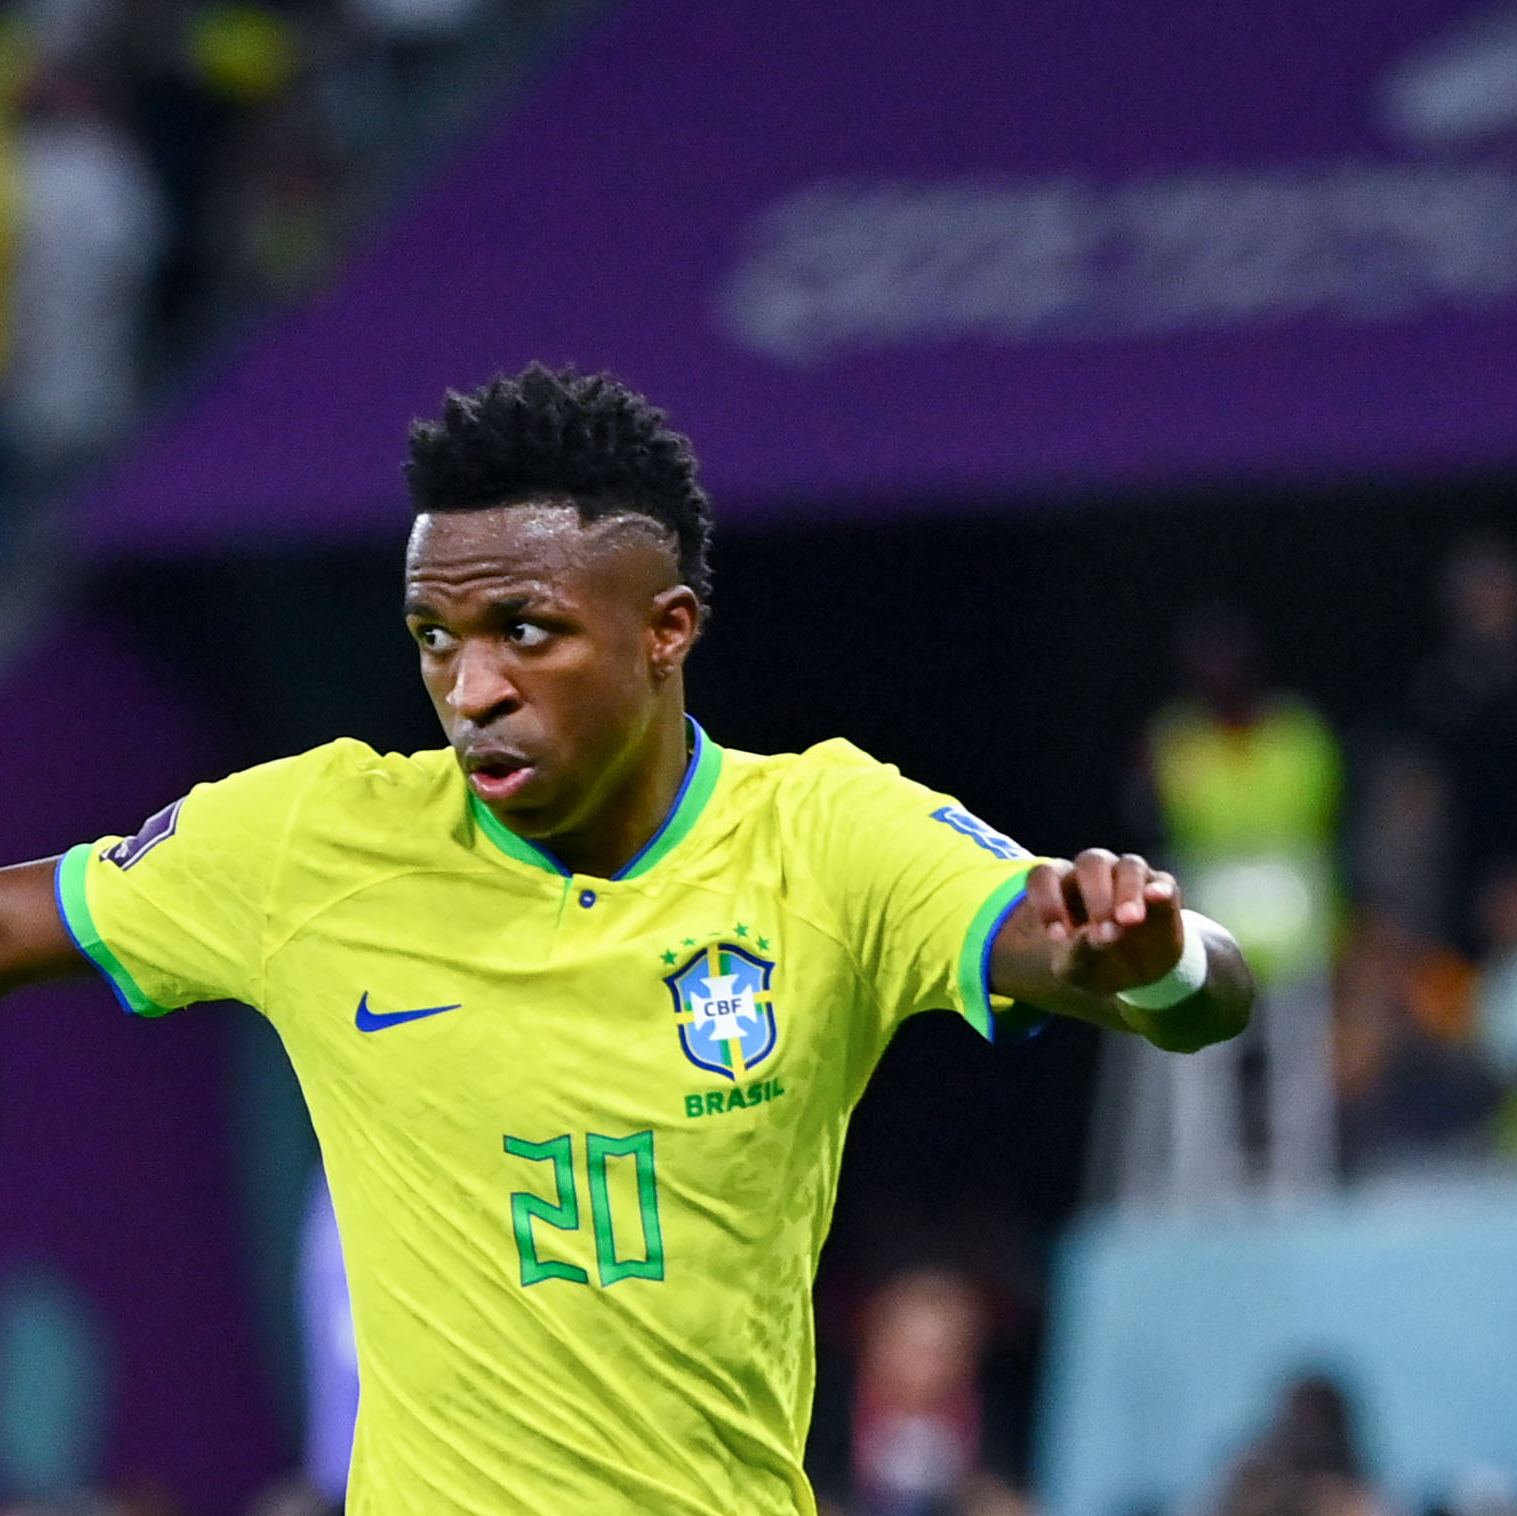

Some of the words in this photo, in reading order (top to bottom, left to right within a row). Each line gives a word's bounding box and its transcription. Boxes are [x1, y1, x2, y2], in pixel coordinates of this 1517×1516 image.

[704, 998, 742, 1017] CBF
[685, 1078, 785, 1118] BRASIL
[503, 1130, 664, 1287] 20
